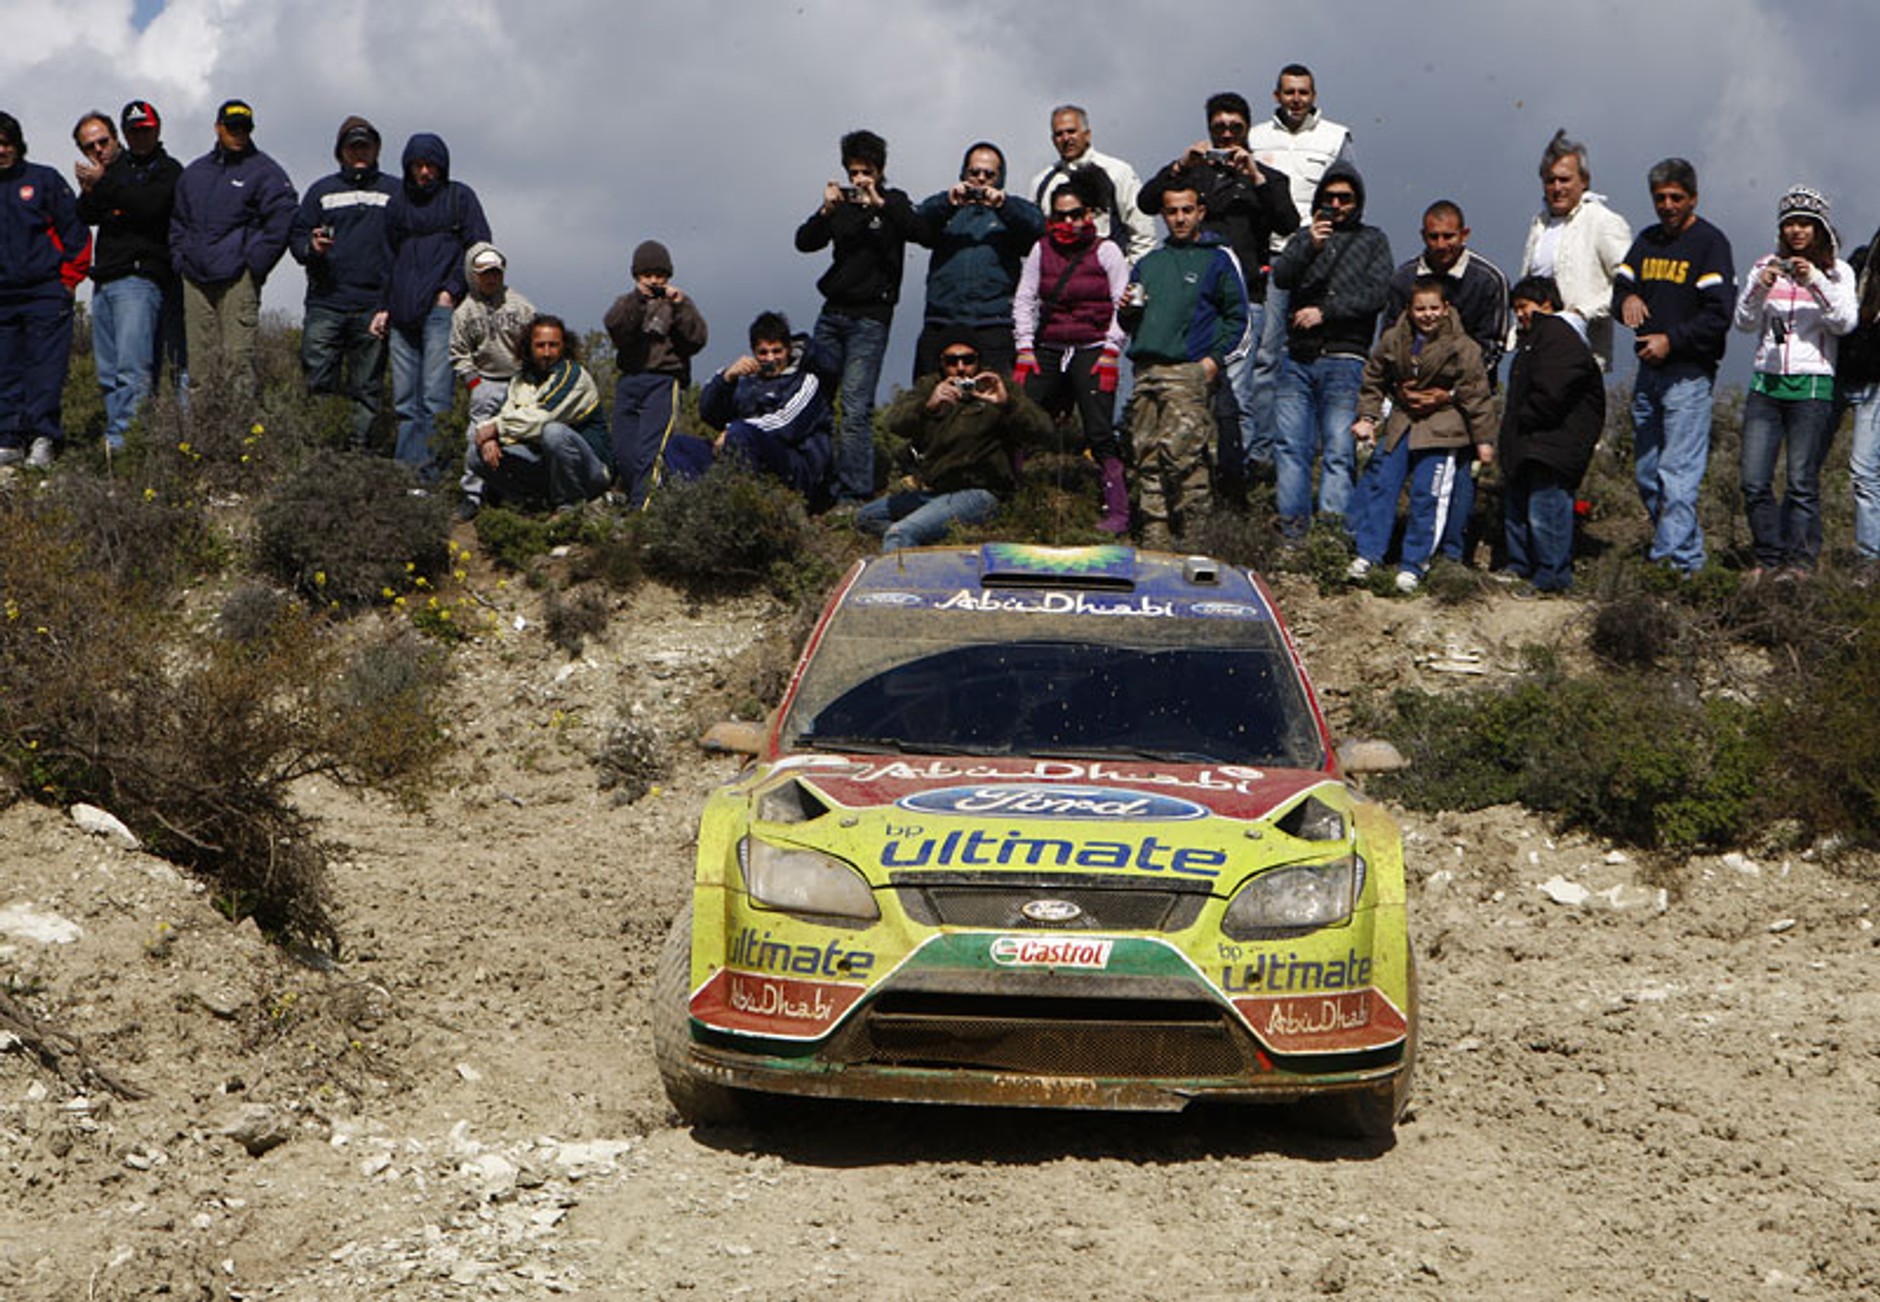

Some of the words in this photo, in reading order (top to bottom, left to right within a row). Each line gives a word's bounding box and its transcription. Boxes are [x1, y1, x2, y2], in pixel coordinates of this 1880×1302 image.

[954, 788, 1151, 815] Ford
[885, 823, 925, 839] bp
[880, 830, 1228, 877] ultimate
[1020, 940, 1103, 965] Castrol
[1218, 943, 1242, 961] bp
[1222, 947, 1372, 993] ultimate
